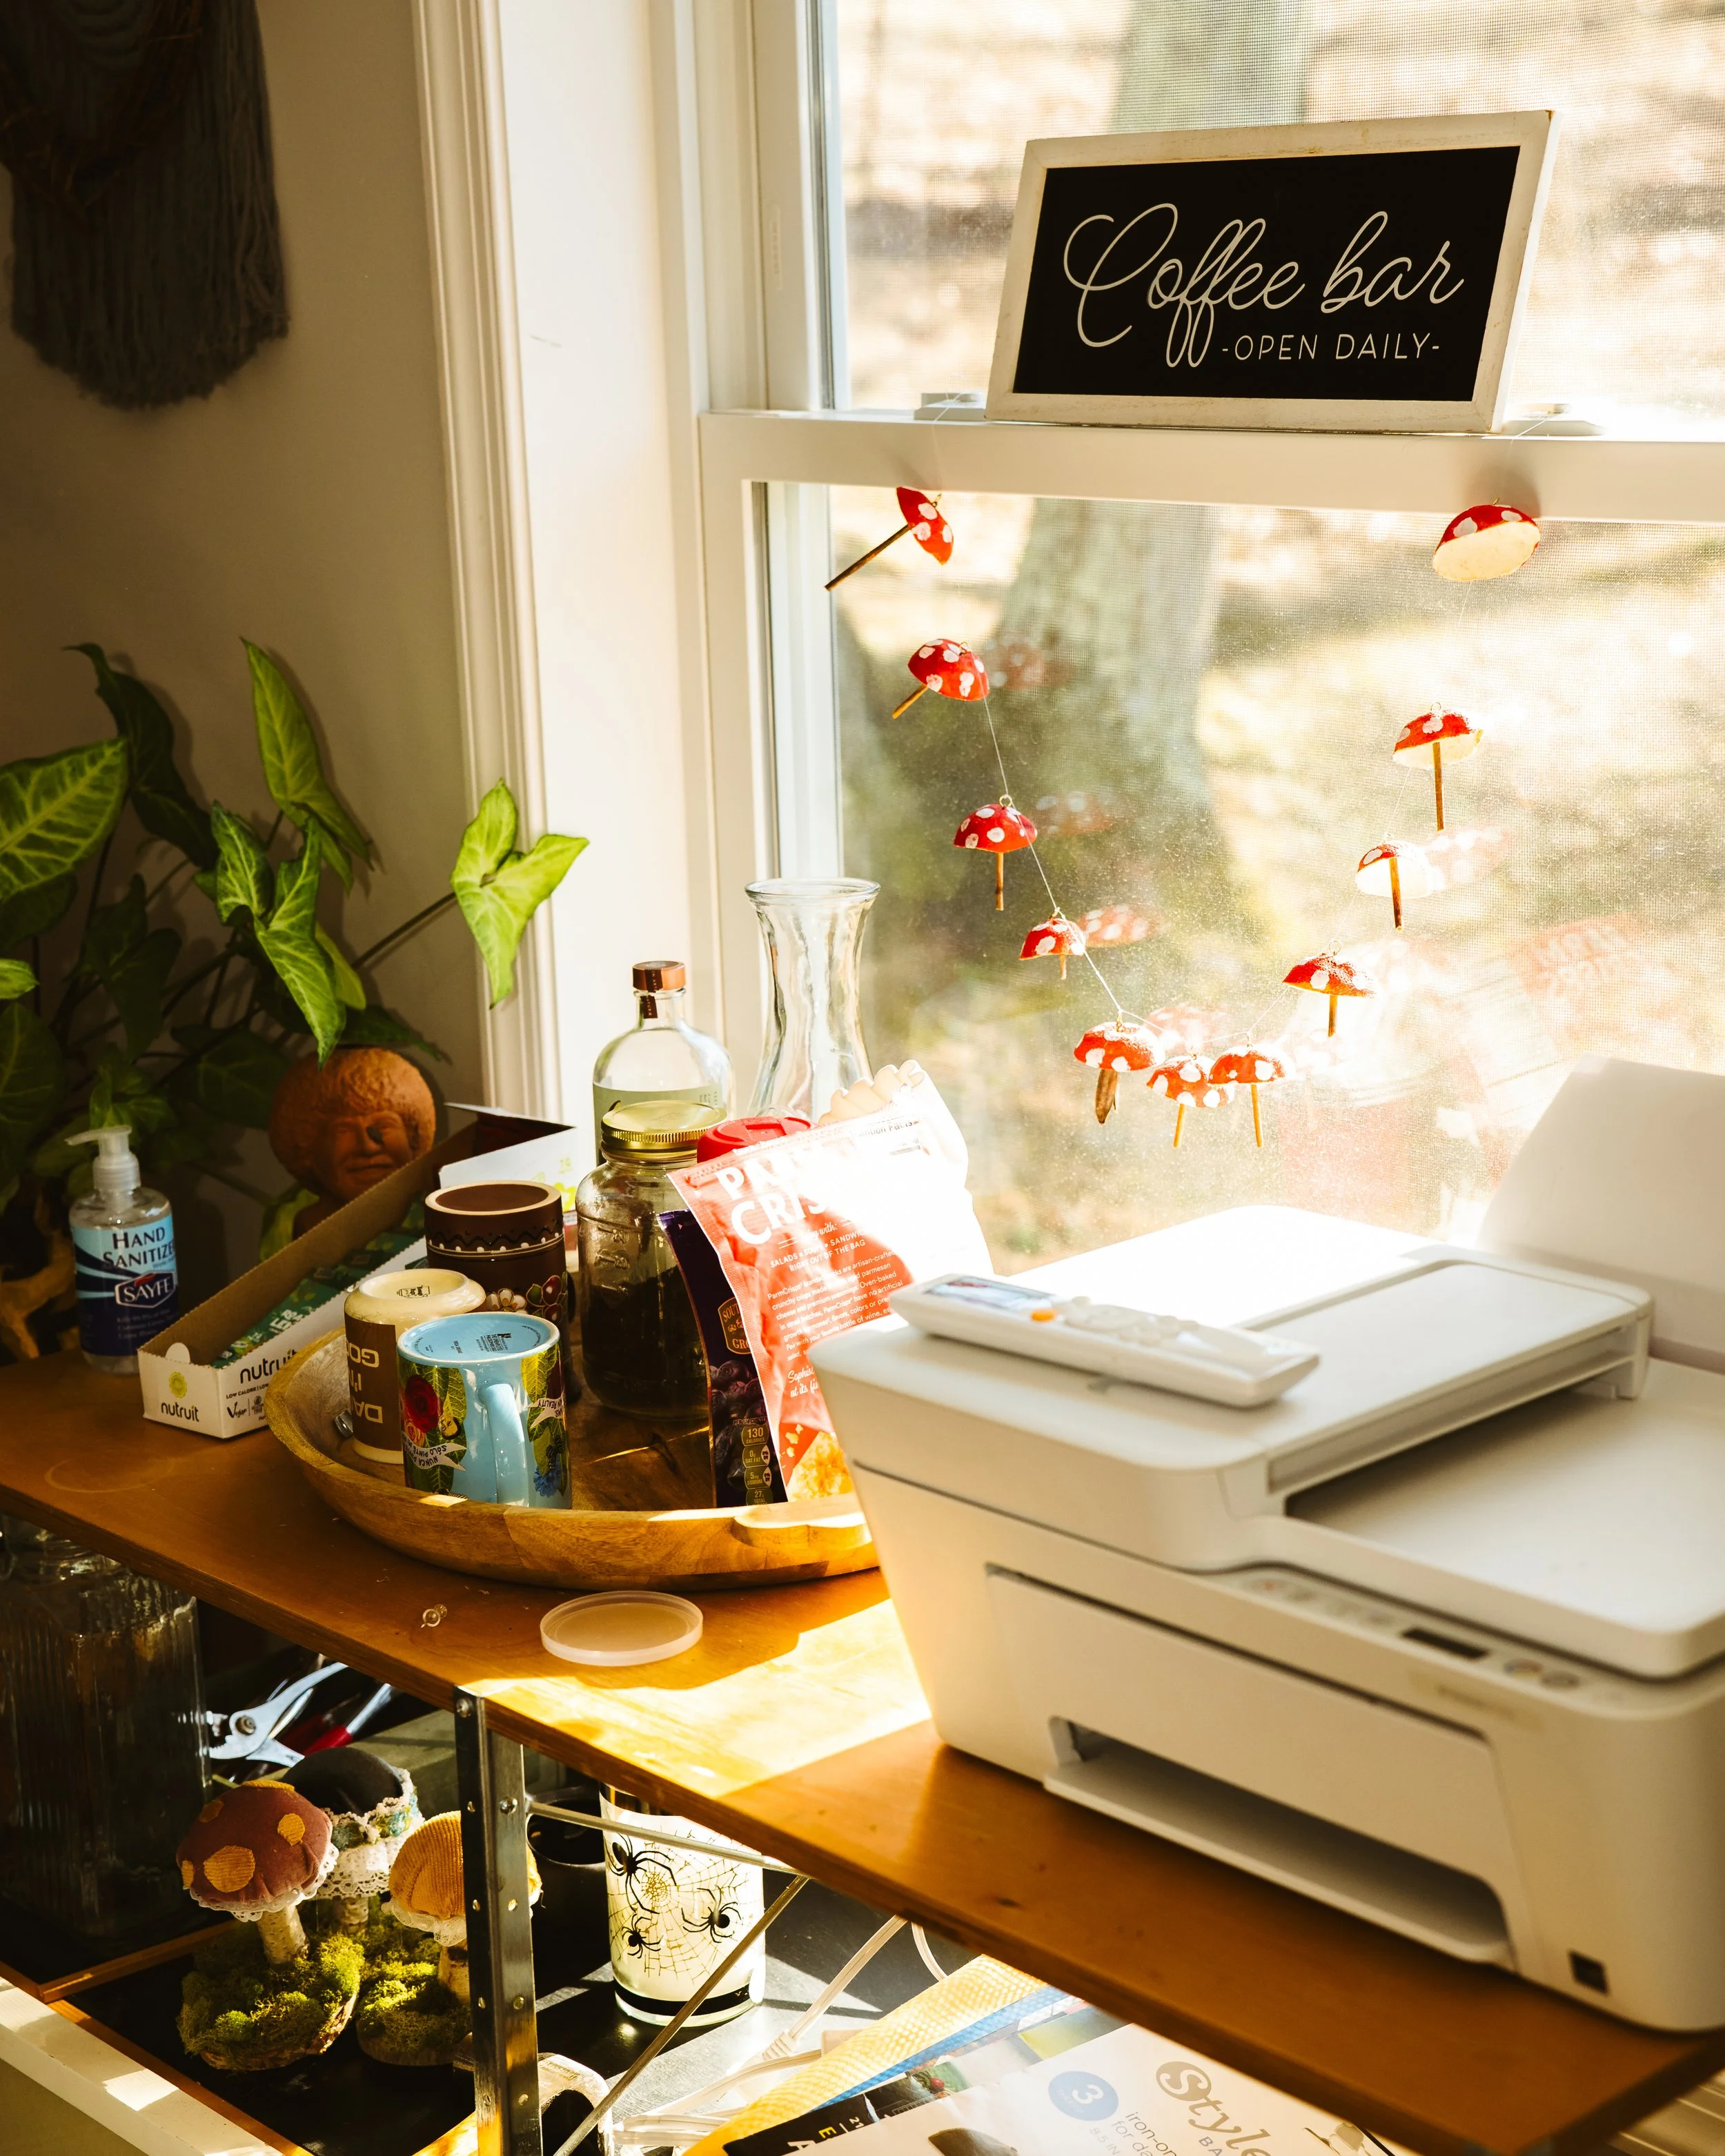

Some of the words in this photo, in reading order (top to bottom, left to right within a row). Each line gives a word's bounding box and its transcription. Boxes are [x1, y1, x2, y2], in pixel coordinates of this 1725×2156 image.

[1064, 203, 1304, 368] Coffee
[1321, 211, 1464, 313] bar
[112, 1227, 165, 1249] HAND
[770, 1252, 798, 1267] SALADS
[829, 1229, 864, 1246] SANDWIC
[809, 1254, 823, 1263] OUT
[823, 1250, 833, 1258] OF
[834, 1245, 849, 1254] THE
[850, 1239, 865, 1249] BAG
[771, 1297, 796, 1311] crunchy
[861, 1262, 891, 1278] parmesan
[859, 1271, 896, 1288] Oven-baked
[853, 1292, 867, 1302] have
[877, 1280, 903, 1293] artificial
[722, 1303, 740, 1322] SOUT
[783, 1329, 801, 1341] growth
[849, 1303, 868, 1314] colors
[839, 1318, 856, 1329] bottle
[864, 1309, 882, 1321] wine,
[161, 1402, 199, 1422] nutruit
[747, 1427, 764, 1438] 130
[418, 1456, 438, 1467] NUNCA
[1072, 2084, 1104, 2104] 3
[1111, 2121, 1134, 2138] for
